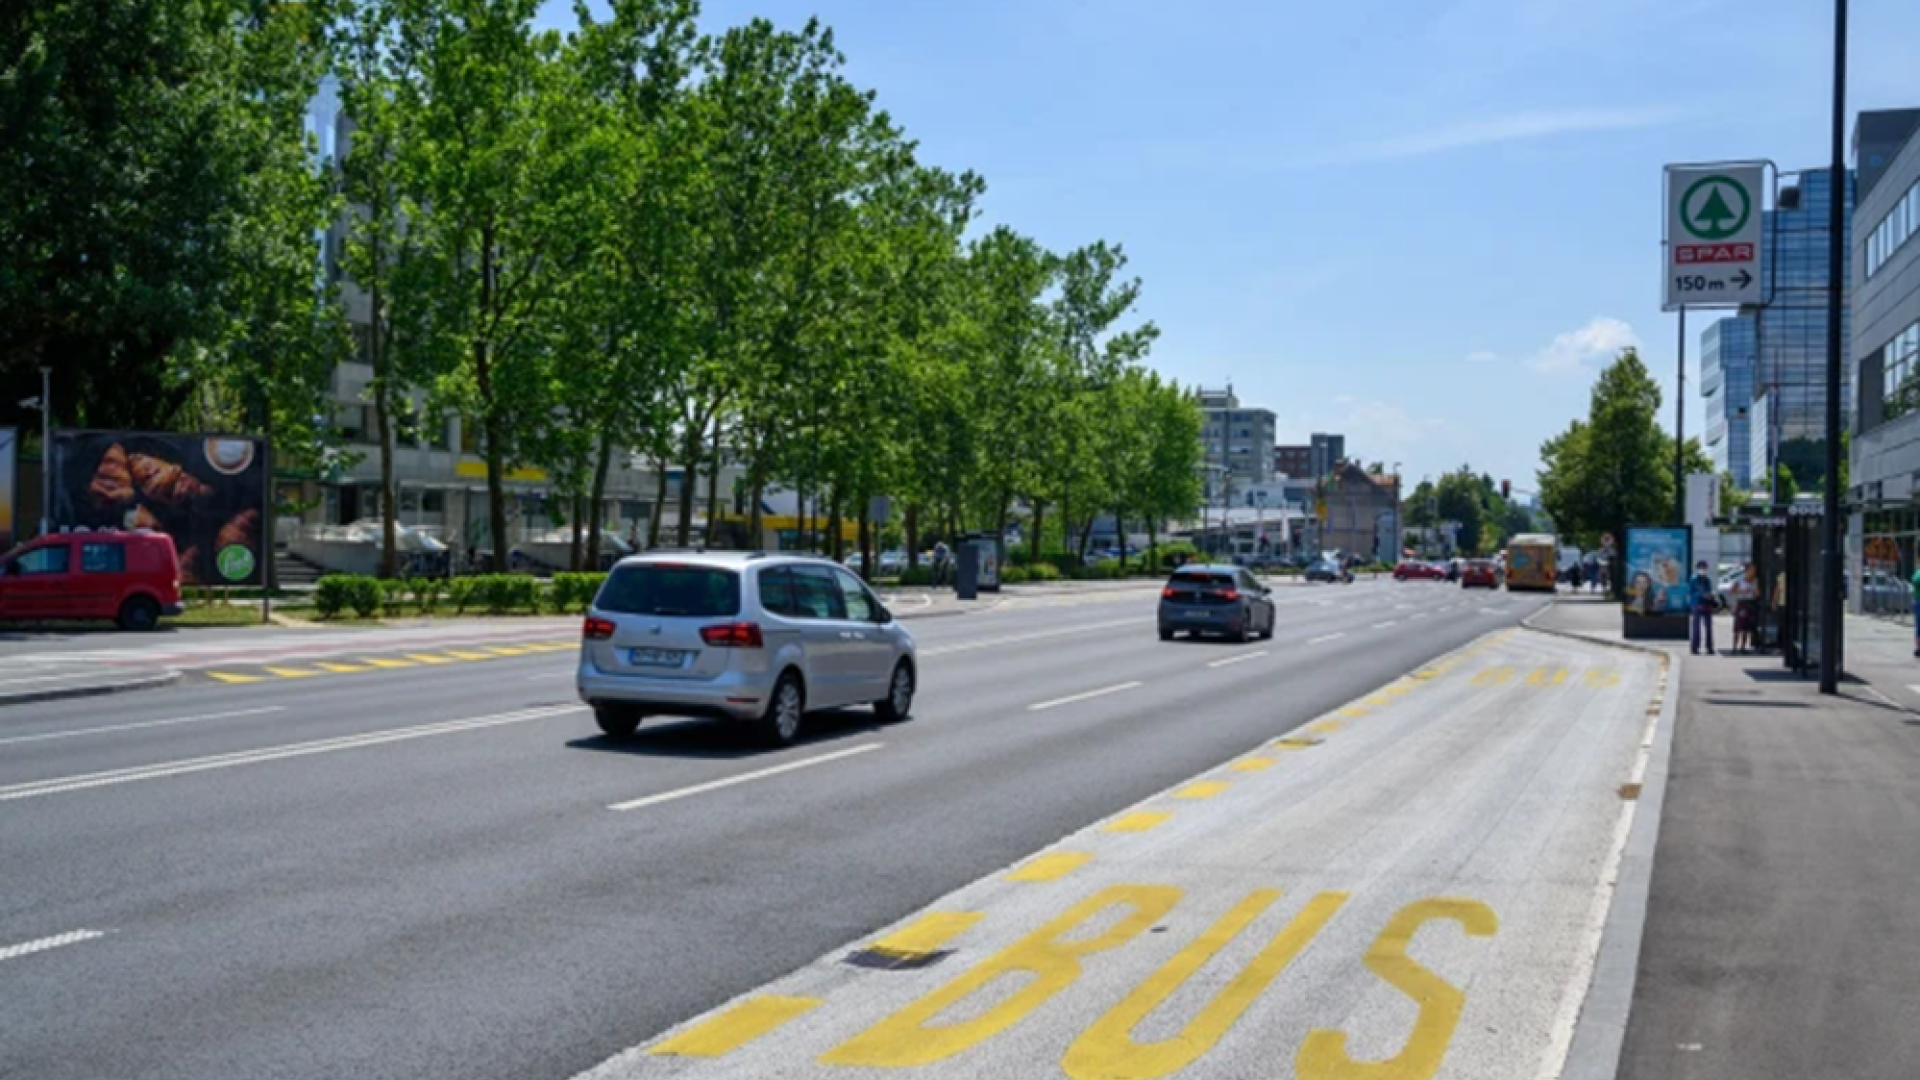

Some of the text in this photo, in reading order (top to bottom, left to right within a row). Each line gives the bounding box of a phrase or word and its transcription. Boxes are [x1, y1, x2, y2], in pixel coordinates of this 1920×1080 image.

[1678, 245, 1751, 261] SPAR
[1676, 275, 1724, 291] 150 m
[816, 884, 1498, 1080] BUS
